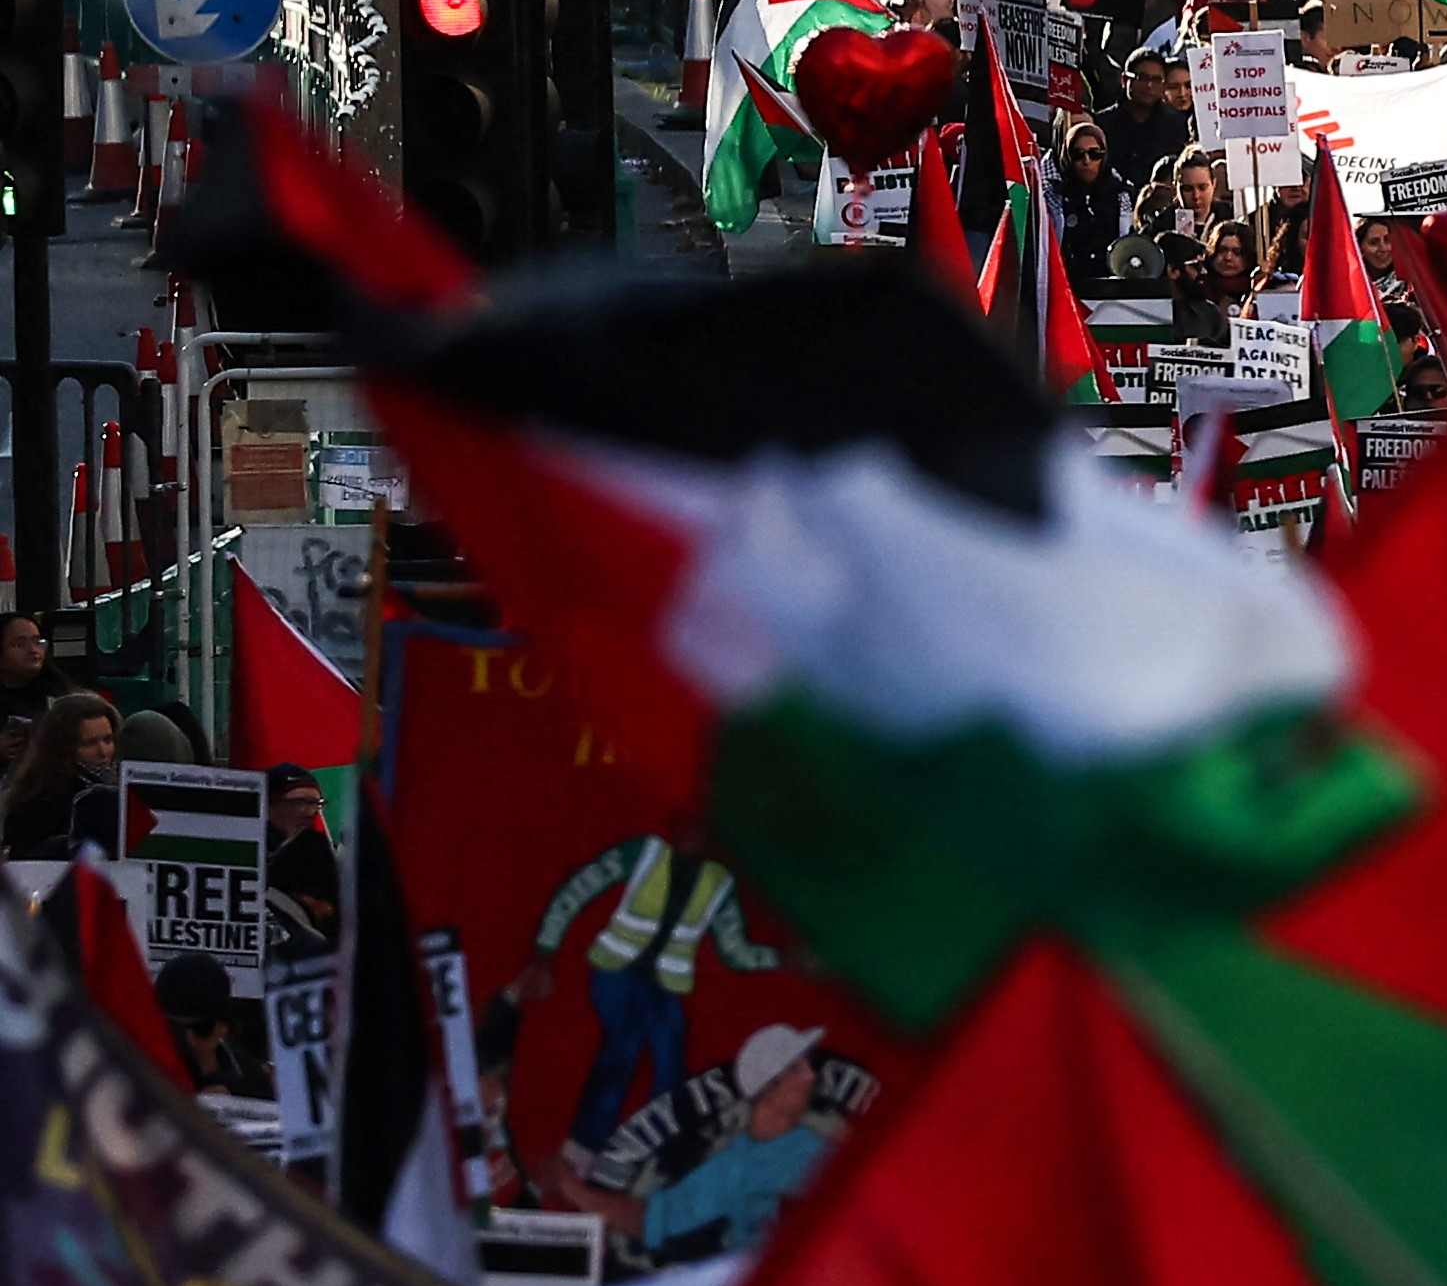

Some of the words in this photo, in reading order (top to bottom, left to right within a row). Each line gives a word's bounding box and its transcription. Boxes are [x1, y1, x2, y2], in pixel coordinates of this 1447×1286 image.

[1004, 36, 1044, 74] NOW!
[1234, 67, 1266, 79] STOP
[1220, 86, 1283, 99] BOMBING
[1235, 323, 1308, 349] TEACHERS
[1238, 347, 1302, 369] AGAINST
[156, 863, 259, 921] REE
[151, 920, 259, 951] ALESTINE
